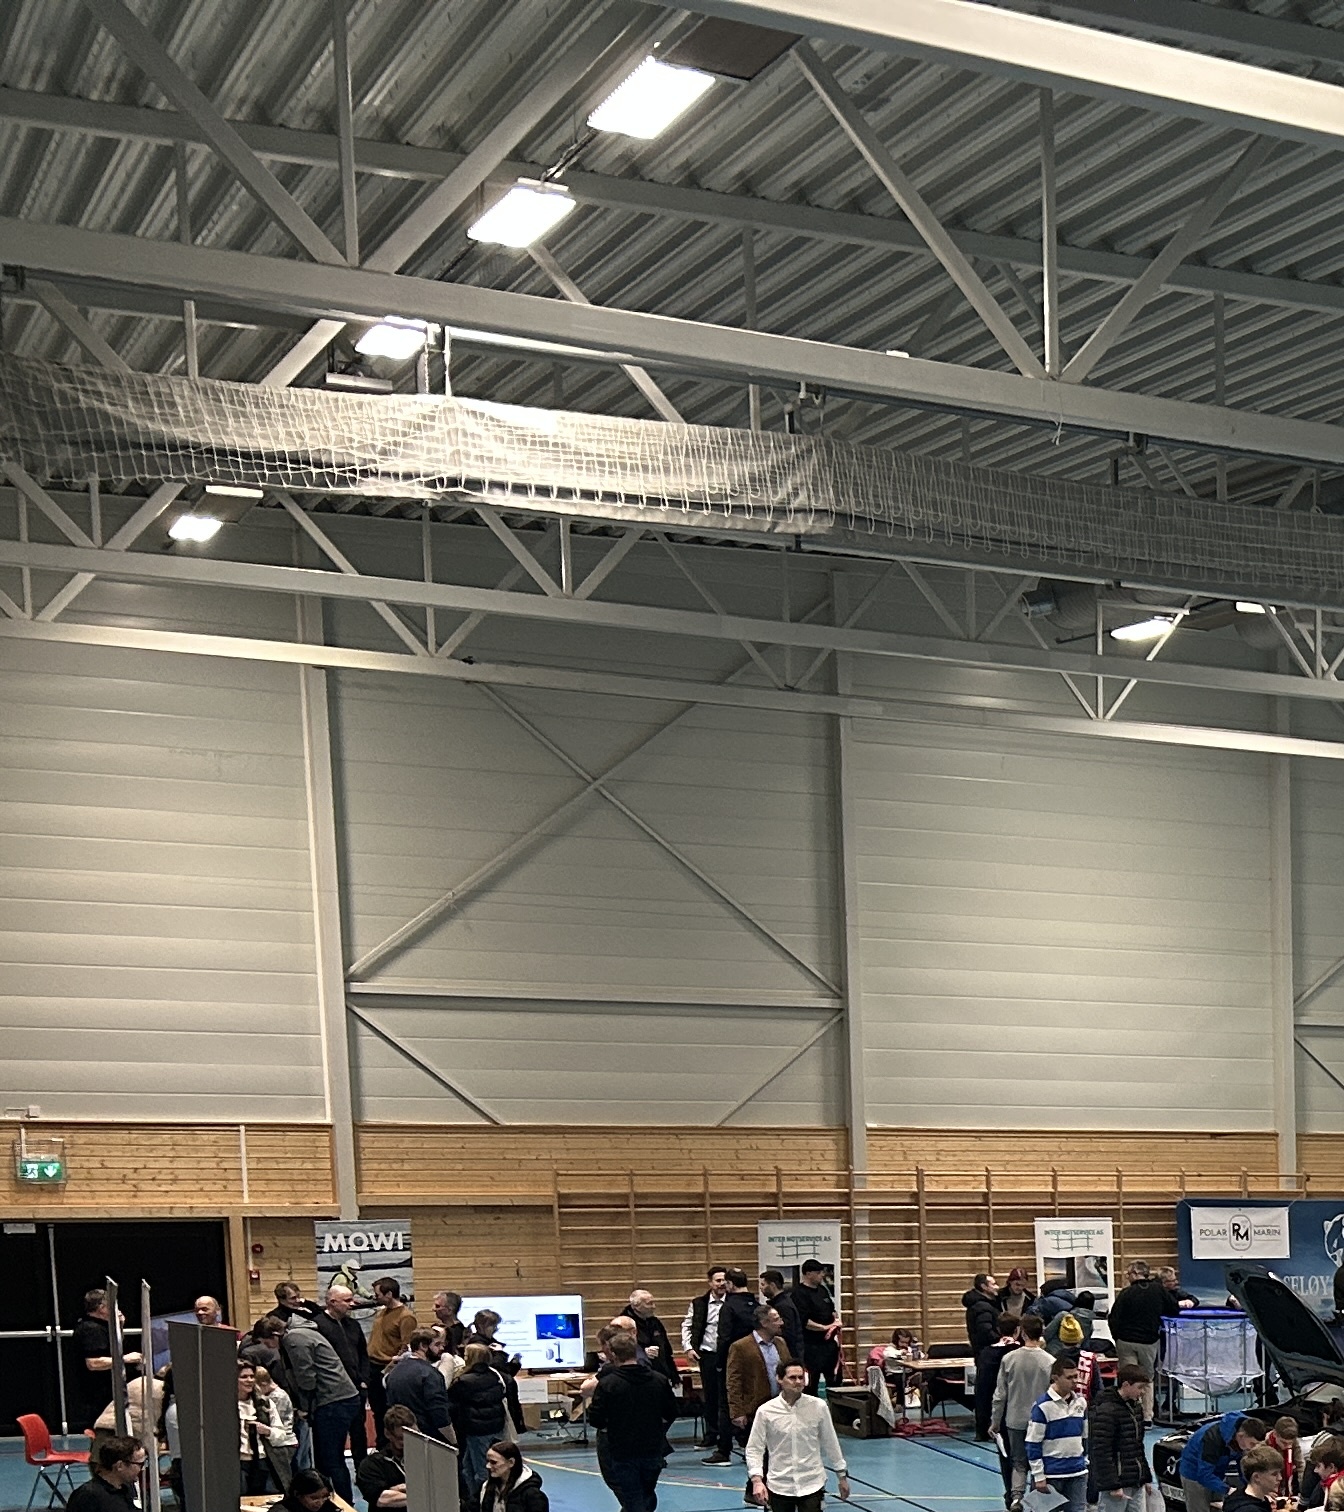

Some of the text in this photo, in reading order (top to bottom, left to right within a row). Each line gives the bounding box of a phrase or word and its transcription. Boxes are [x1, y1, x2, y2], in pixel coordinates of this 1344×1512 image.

[1199, 1228, 1227, 1237] POLAR
[1253, 1228, 1281, 1236] MARIN
[323, 1231, 404, 1253] MOWI
